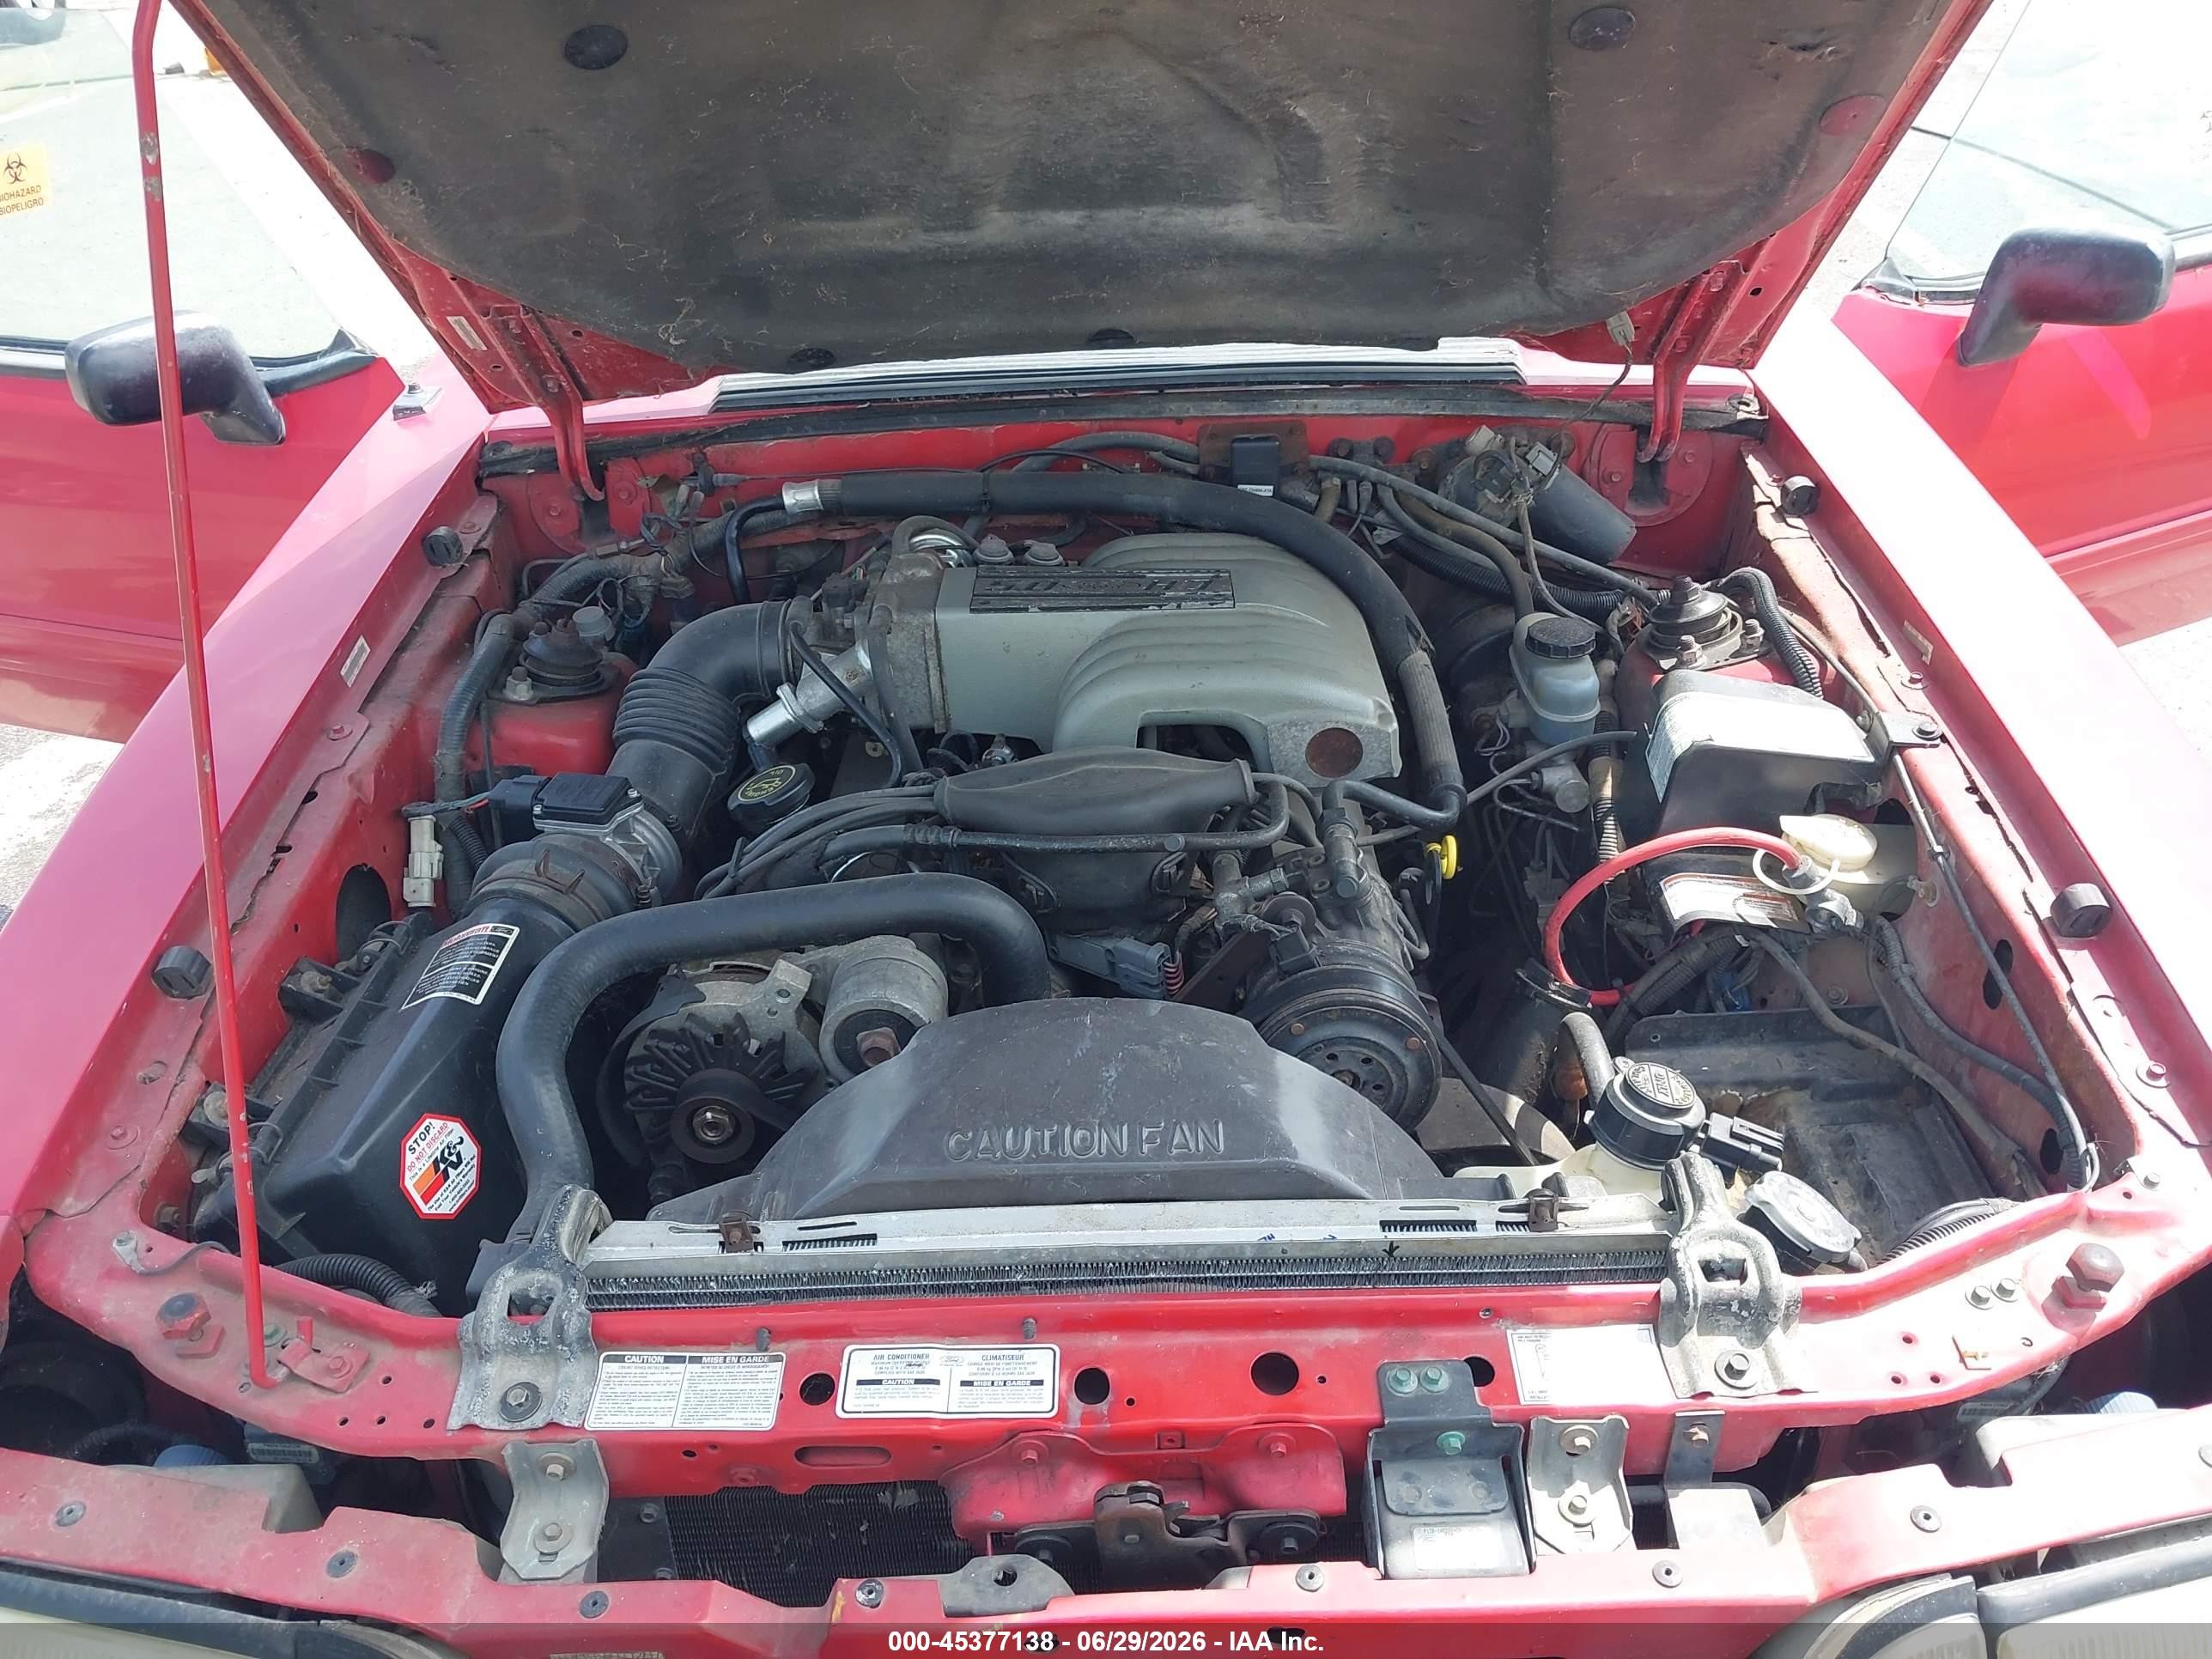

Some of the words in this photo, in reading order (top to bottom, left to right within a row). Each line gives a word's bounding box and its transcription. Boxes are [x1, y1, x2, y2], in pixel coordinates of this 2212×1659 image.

[407, 1161, 416, 1172] DO
[416, 1147, 428, 1164] NOT
[427, 1122, 448, 1149] DISCARD
[408, 1121, 435, 1155] STOP!
[946, 1119, 1127, 1161] CAUTION
[1138, 1118, 1224, 1155] FAN
[624, 1355, 665, 1364] CAUTION
